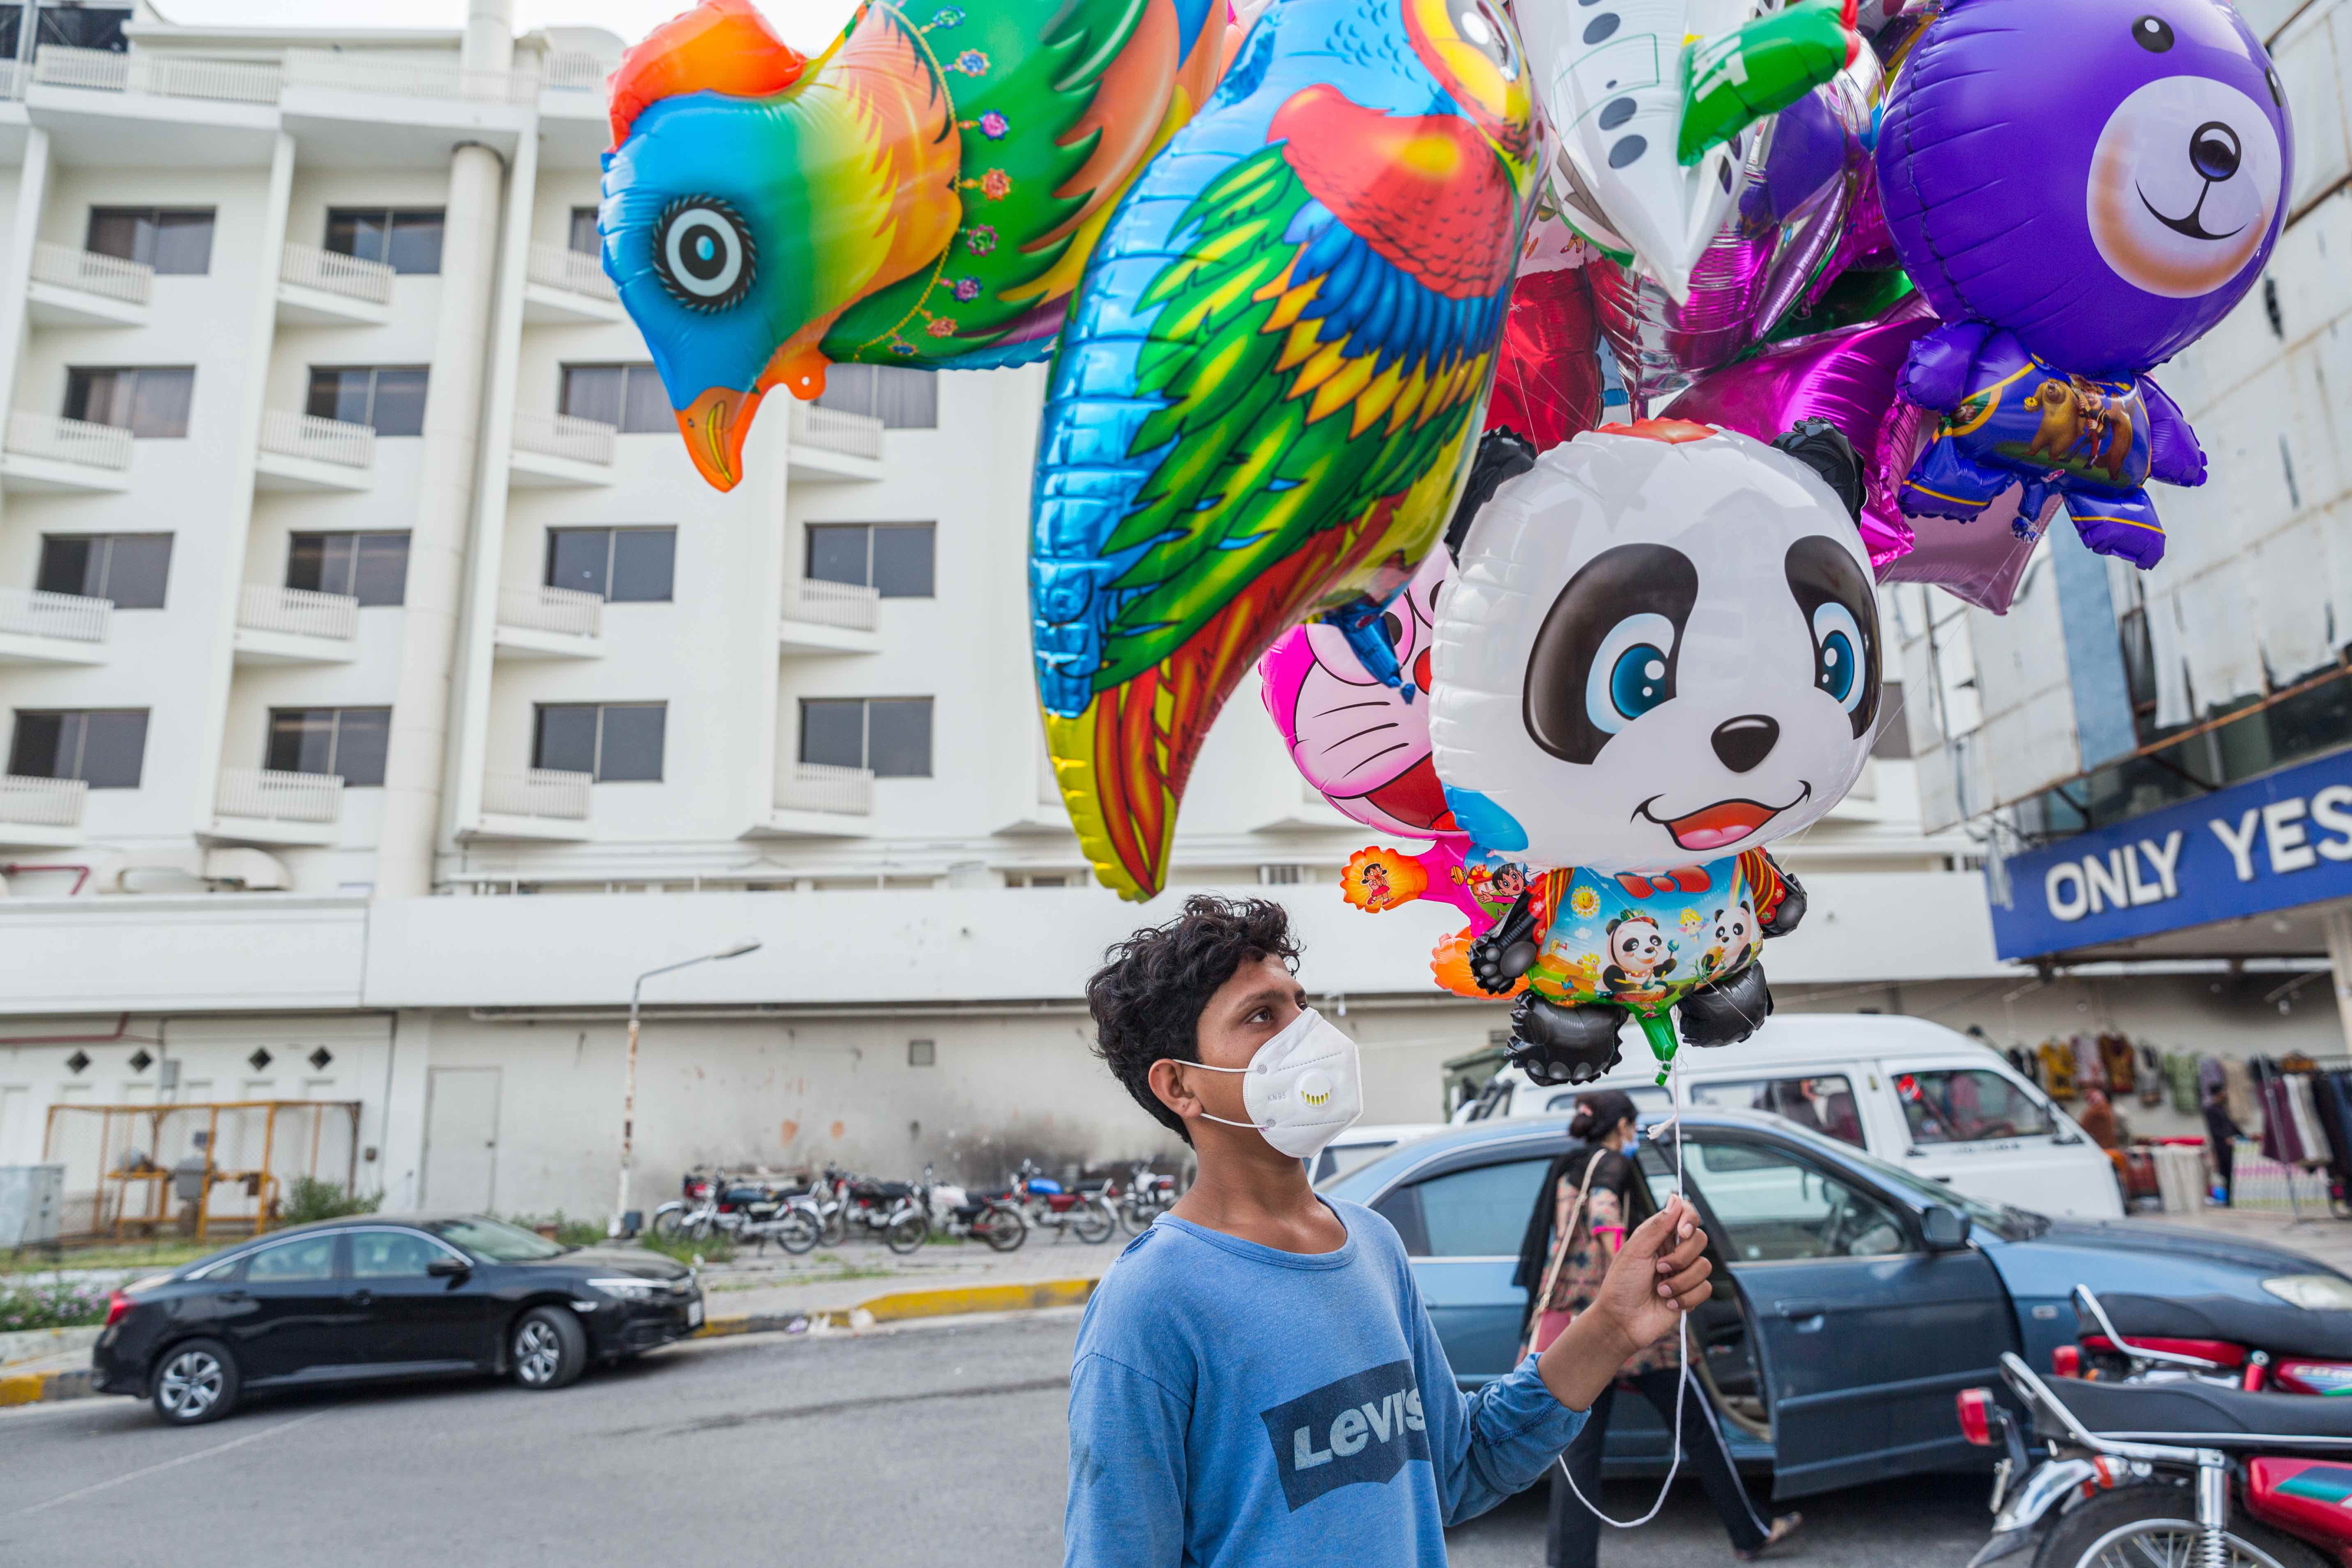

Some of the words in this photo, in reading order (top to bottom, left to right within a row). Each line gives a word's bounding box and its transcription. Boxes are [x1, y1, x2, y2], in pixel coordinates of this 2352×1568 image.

[2044, 830, 2184, 921] ONLY
[2209, 785, 2352, 882] YES
[1268, 1091, 1286, 1101] KN95
